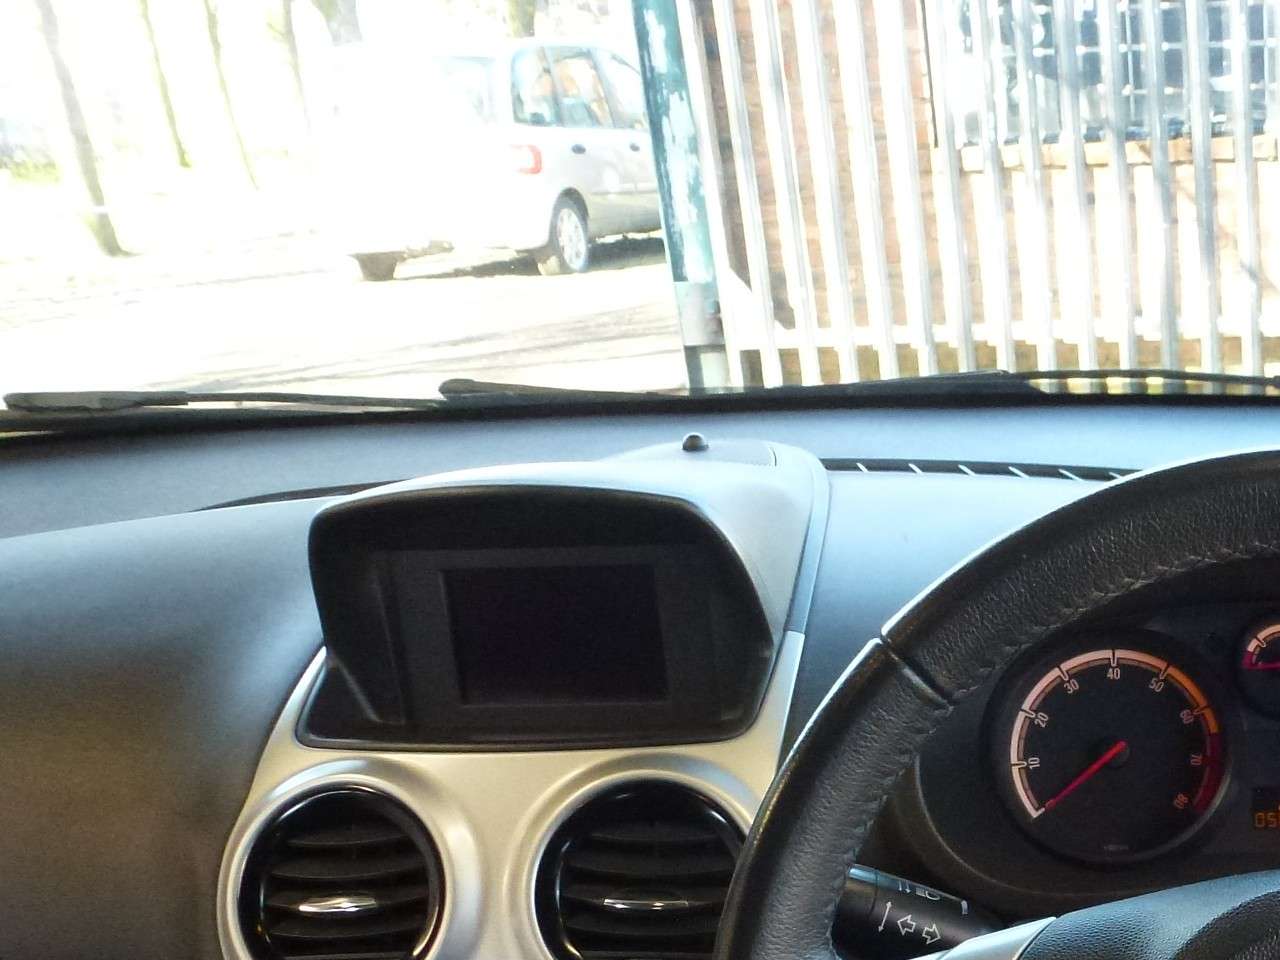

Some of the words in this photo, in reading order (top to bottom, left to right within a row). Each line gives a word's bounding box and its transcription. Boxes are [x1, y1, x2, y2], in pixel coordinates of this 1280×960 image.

[1106, 667, 1121, 680] 40
[1063, 678, 1080, 694] 30
[1148, 677, 1165, 693] 50
[1034, 711, 1049, 728] 20
[1029, 756, 1041, 769] 10
